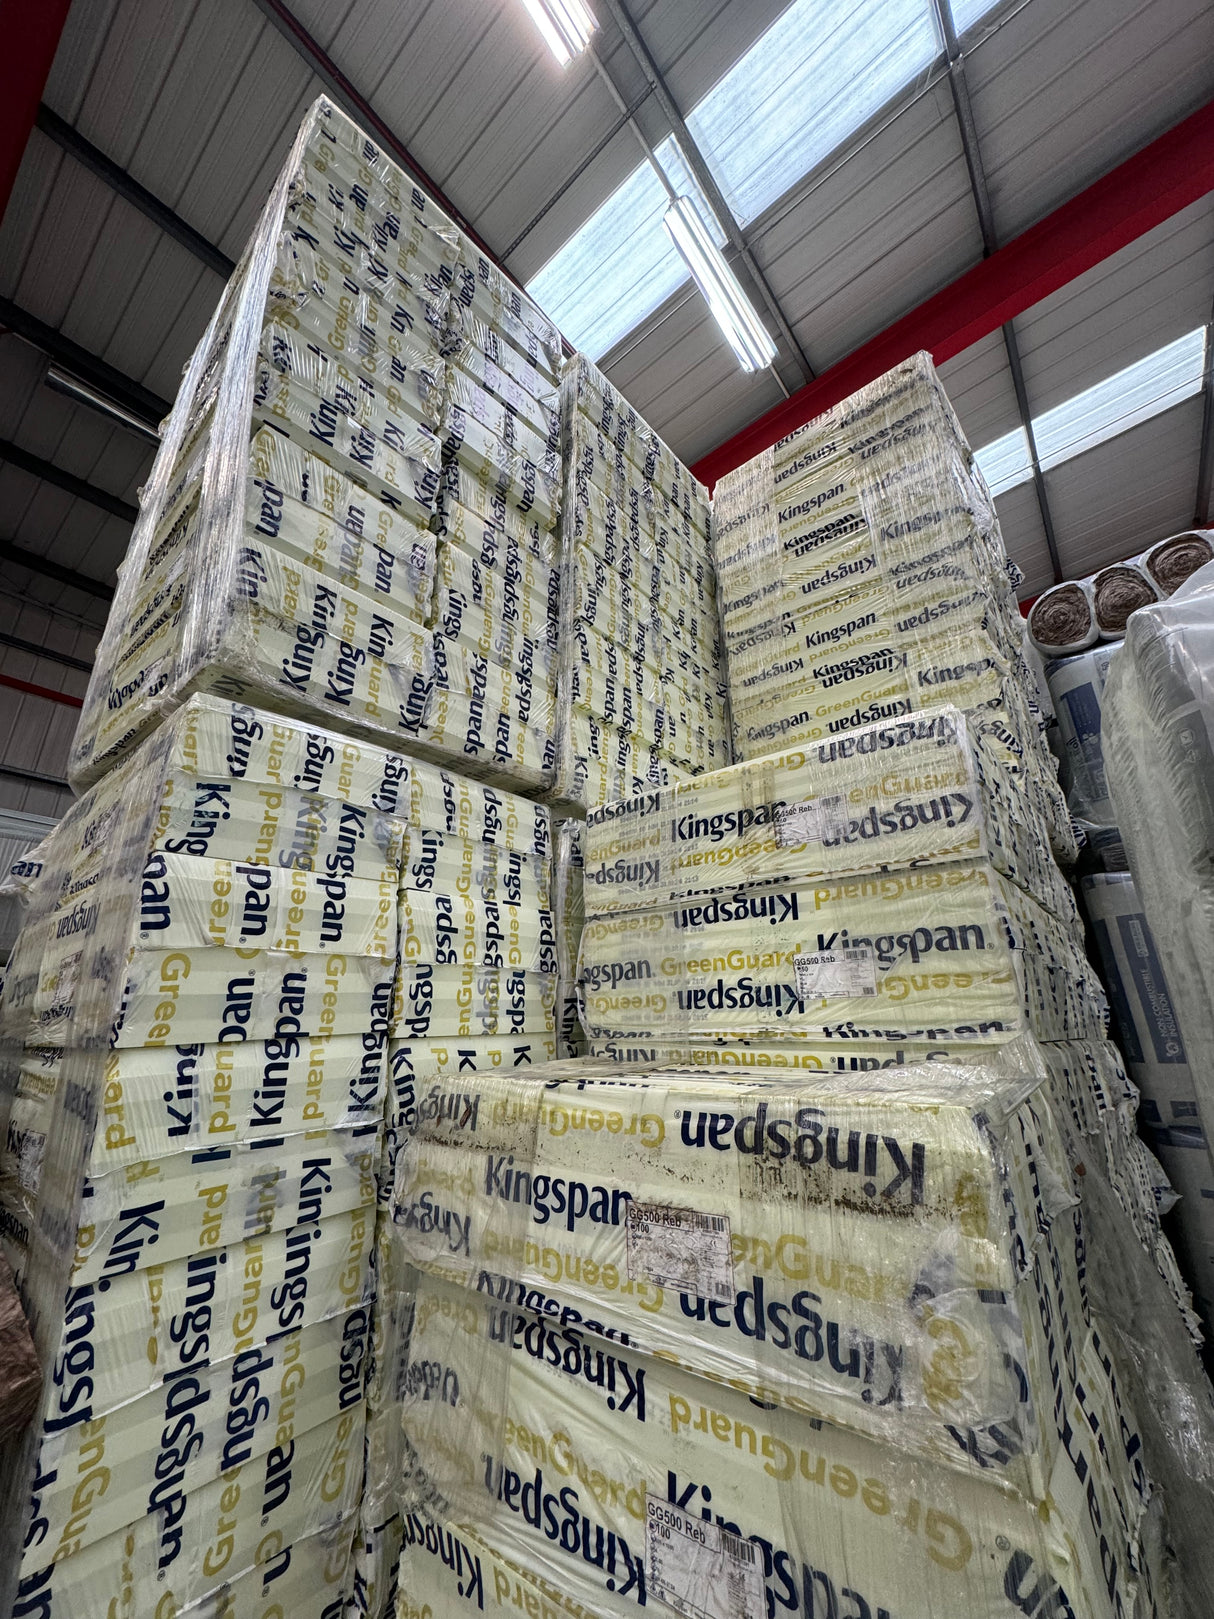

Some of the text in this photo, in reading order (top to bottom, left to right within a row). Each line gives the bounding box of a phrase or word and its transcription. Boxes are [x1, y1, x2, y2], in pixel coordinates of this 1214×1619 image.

[778, 483, 845, 525] Kingspan
[784, 513, 857, 551] Kingspan
[801, 553, 877, 595] Kingspan
[805, 612, 878, 649] Kingspan
[813, 647, 896, 679] Kingspan
[822, 653, 907, 689] Kingspan
[816, 679, 909, 718] GreenGuard
[827, 698, 912, 735] Kingspan
[673, 892, 799, 930] Kingspan
[1158, 992, 1179, 1038] INSULATION
[680, 1103, 925, 1204] Kingspan
[483, 1454, 647, 1606] Kingspan
[648, 1501, 706, 1545] GG500 Reb
